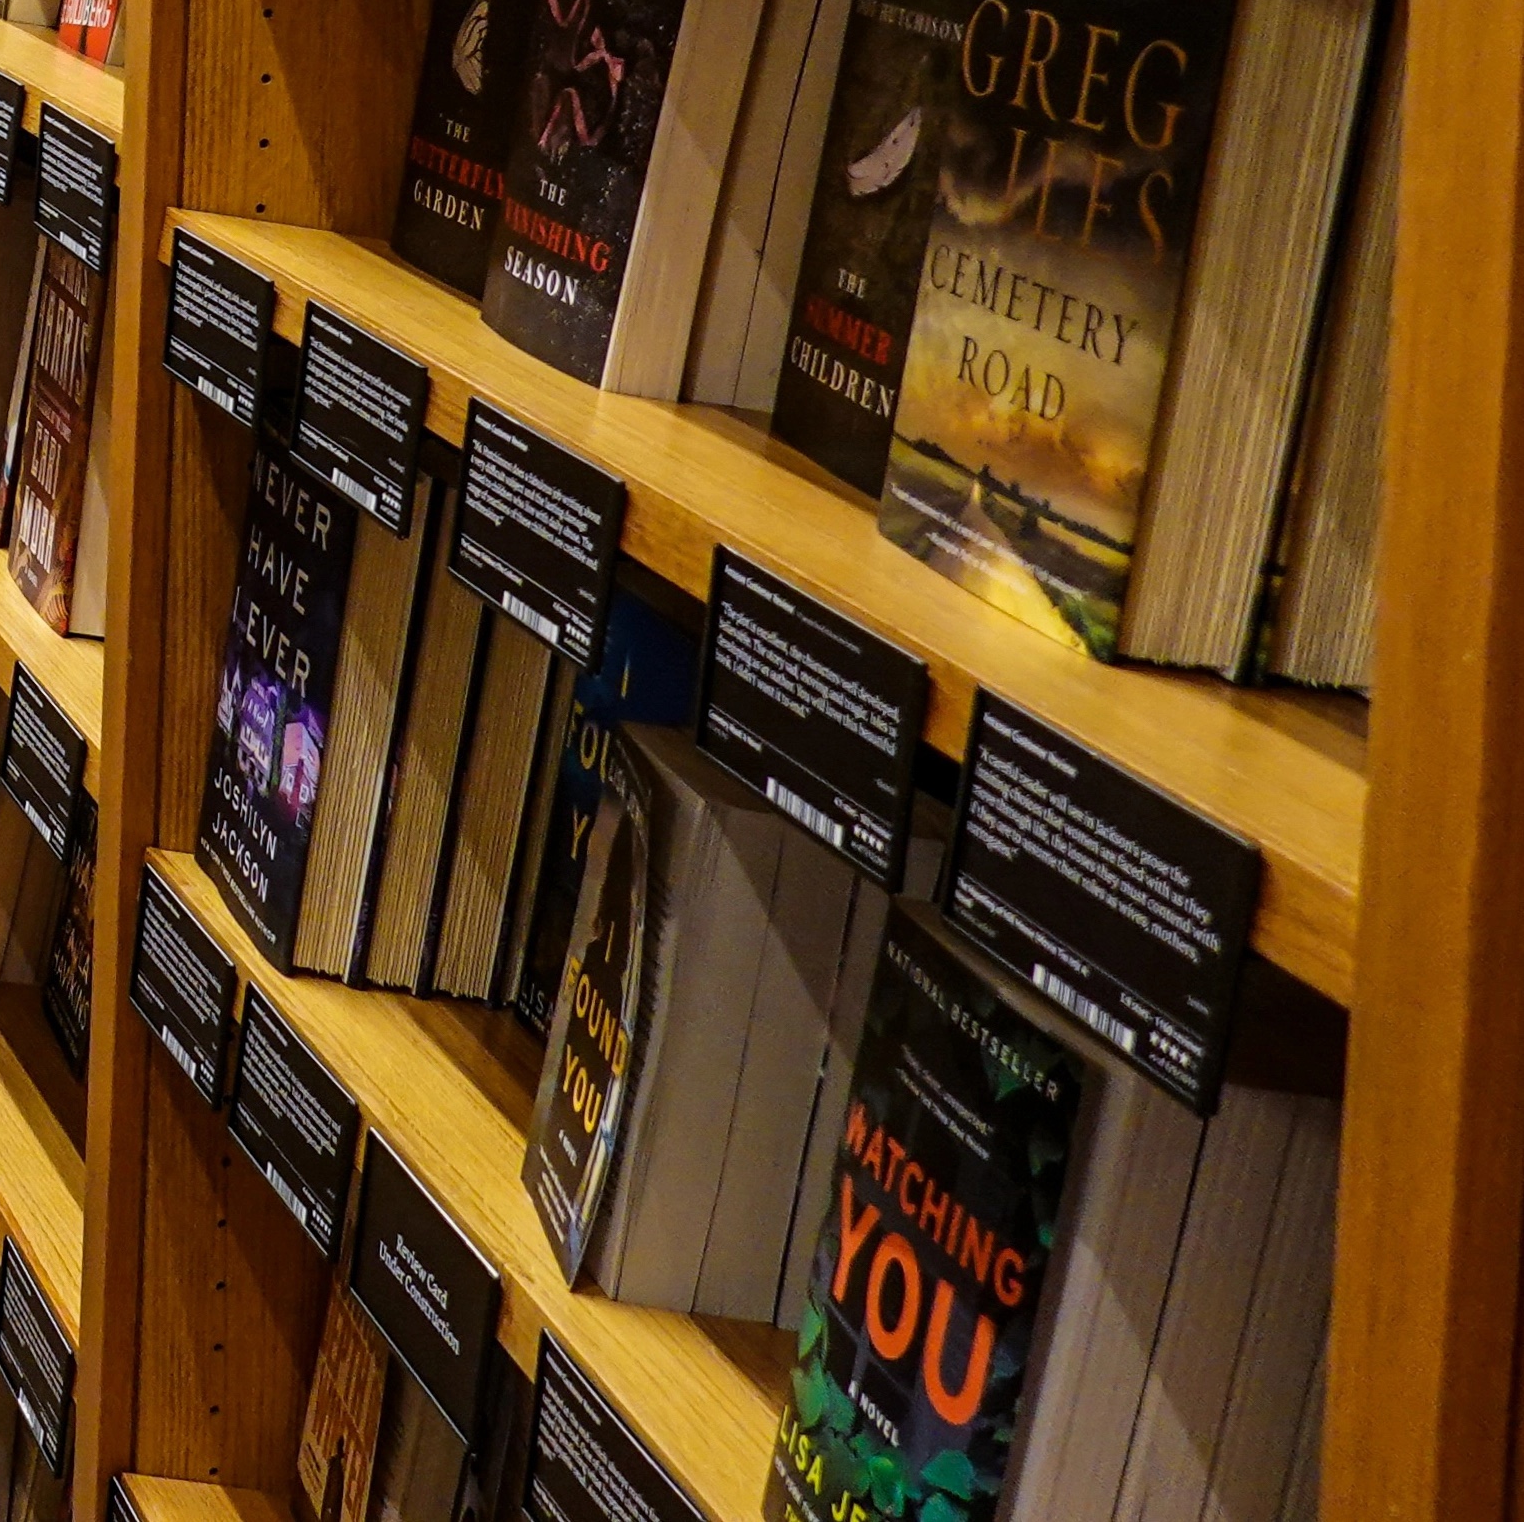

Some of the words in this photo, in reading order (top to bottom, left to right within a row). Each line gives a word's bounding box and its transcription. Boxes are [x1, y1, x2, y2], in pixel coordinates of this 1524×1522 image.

[503, 246, 579, 307] SEASON
[928, 243, 1142, 368] CEMETERY
[790, 335, 897, 419] CHILDREN
[957, 336, 1067, 424] ROAD
[253, 448, 333, 551] NEVER
[247, 523, 309, 616] HAVE
[246, 604, 312, 699] EVER
[211, 811, 270, 905] JACKSON
[214, 769, 278, 863] JOSHILYN
[562, 1043, 604, 1134] YOU
[380, 1240, 405, 1285] Under
[405, 1275, 459, 1356] Construction
[396, 1233, 427, 1283] Review
[427, 1273, 448, 1310] Card
[830, 1173, 998, 1426] YOU
[857, 1390, 902, 1449] NOVEL
